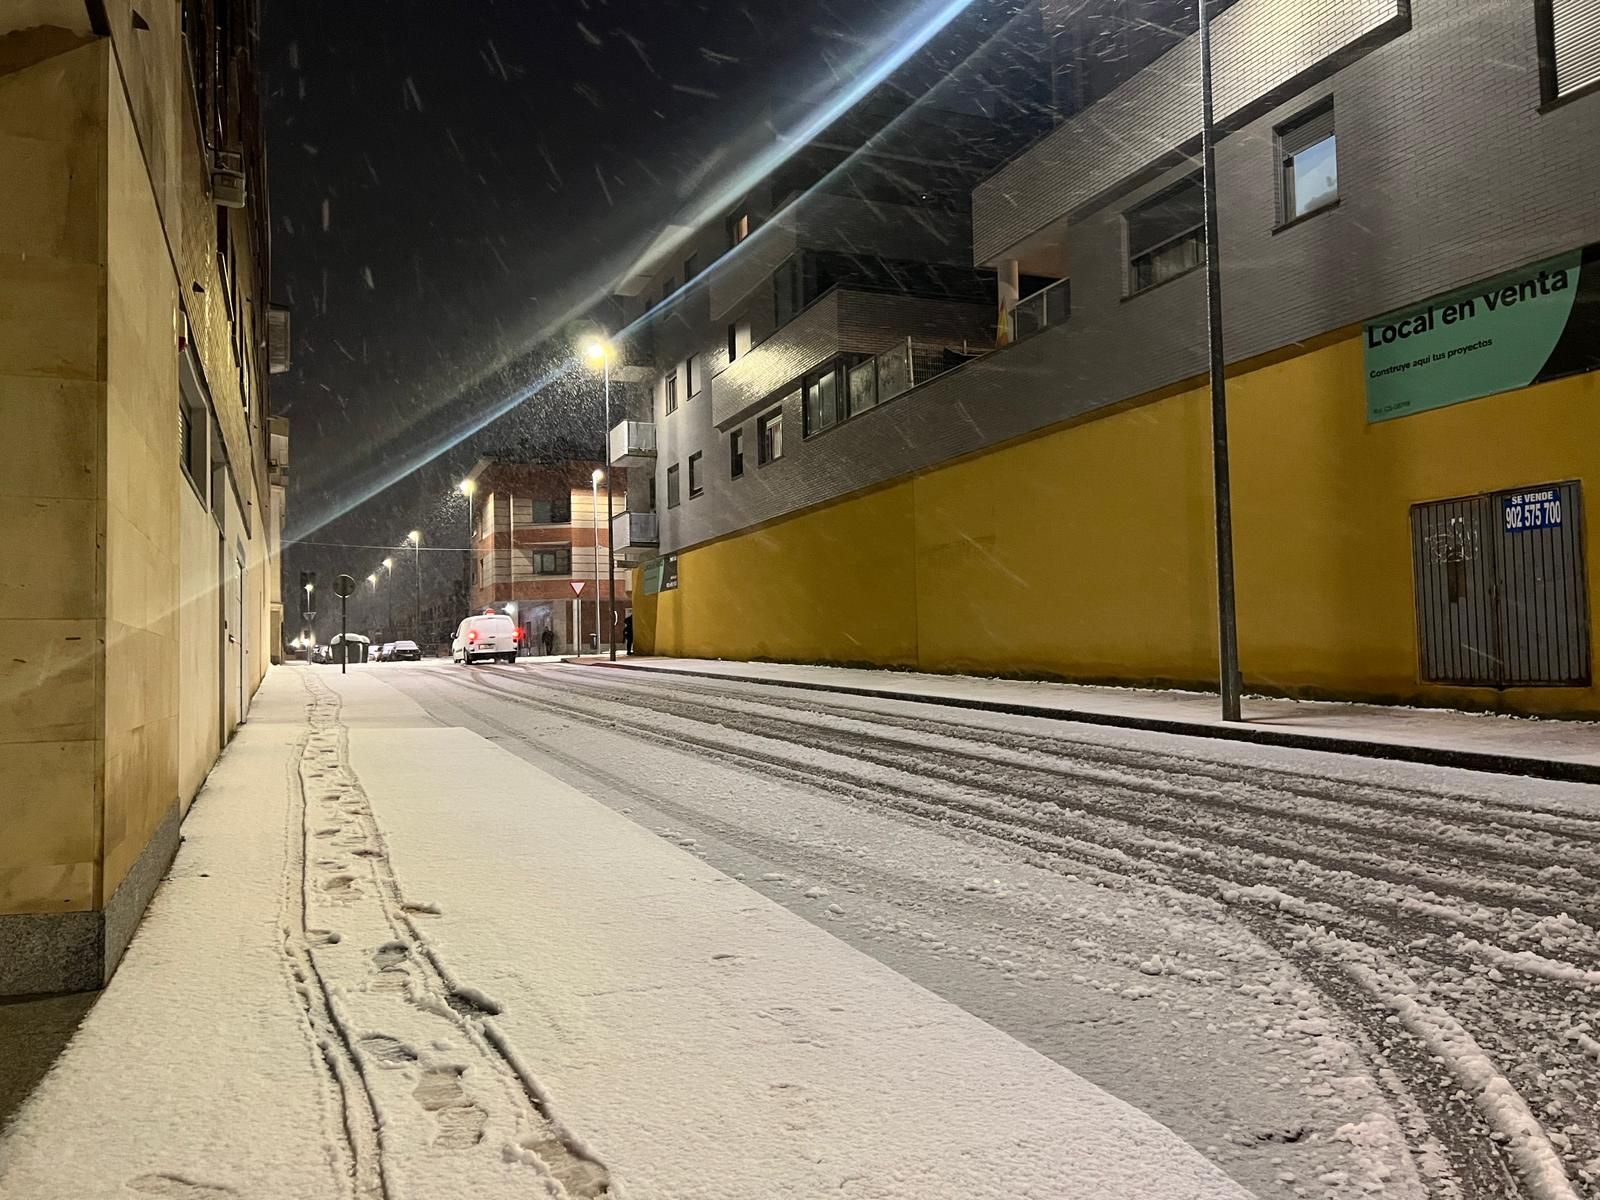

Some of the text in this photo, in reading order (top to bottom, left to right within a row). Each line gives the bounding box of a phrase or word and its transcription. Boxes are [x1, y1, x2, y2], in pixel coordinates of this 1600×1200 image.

[1368, 269, 1568, 348] Local en venta
[1370, 362, 1411, 379] Construye
[1432, 352, 1446, 362] tus
[1447, 338, 1493, 359] proyectos
[1505, 500, 1561, 529] 902 575 700
[1511, 491, 1553, 505] SE VENDE
